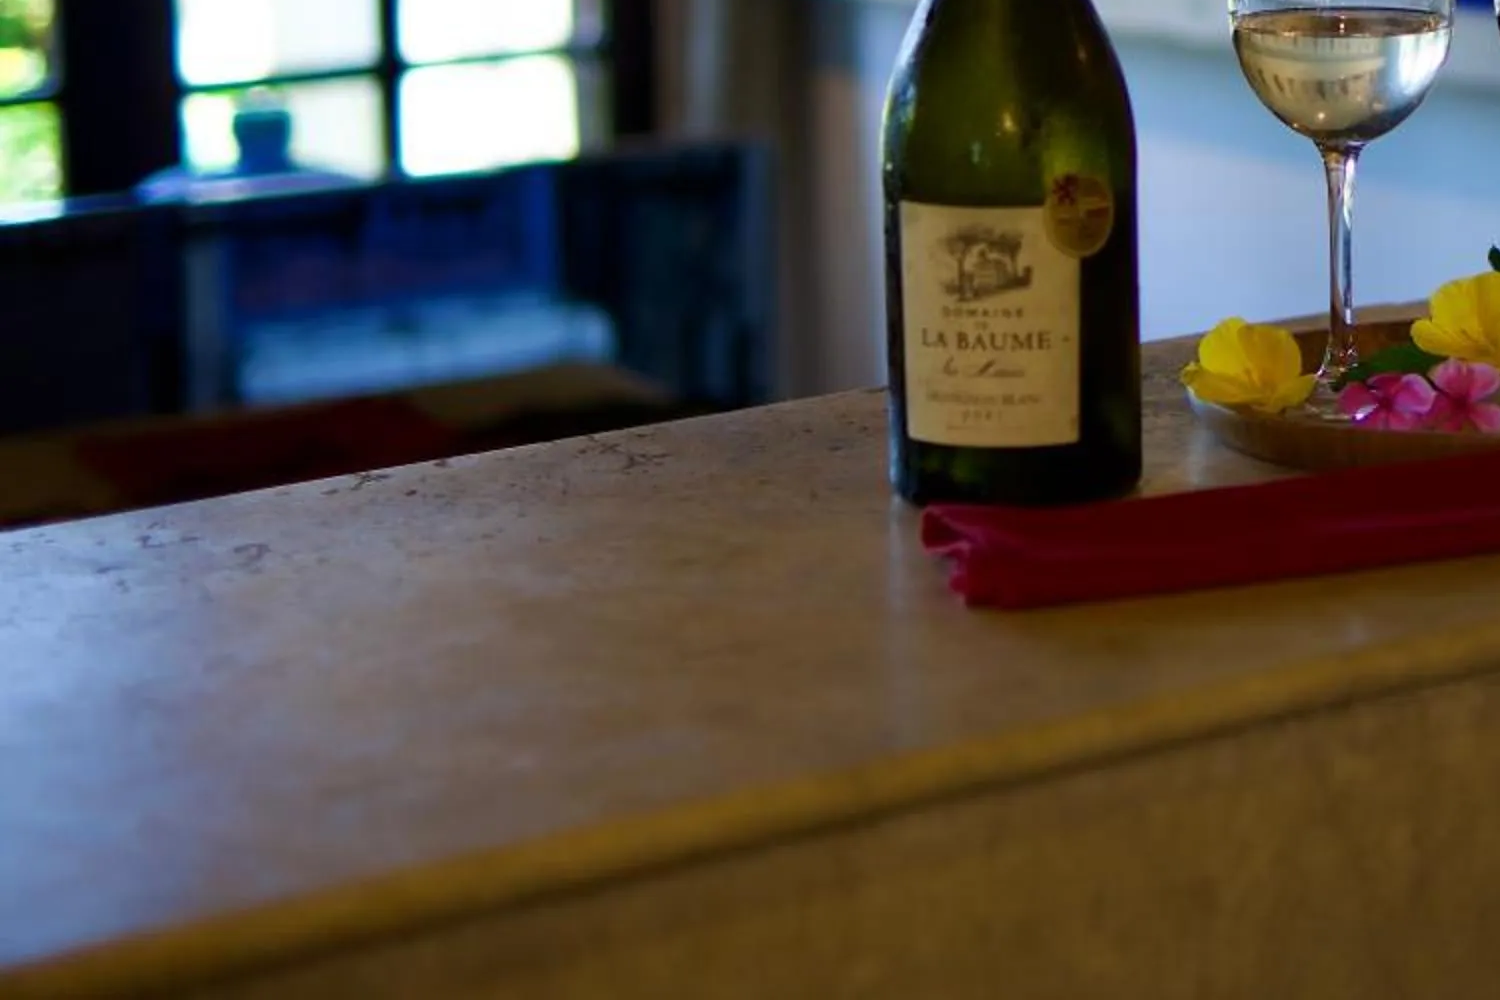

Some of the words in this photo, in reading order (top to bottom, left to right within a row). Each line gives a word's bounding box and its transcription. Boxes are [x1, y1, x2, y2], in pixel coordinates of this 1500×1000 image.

[941, 306, 1025, 319] DOMAINE
[921, 327, 948, 348] LA
[956, 330, 1052, 350] BAUME
